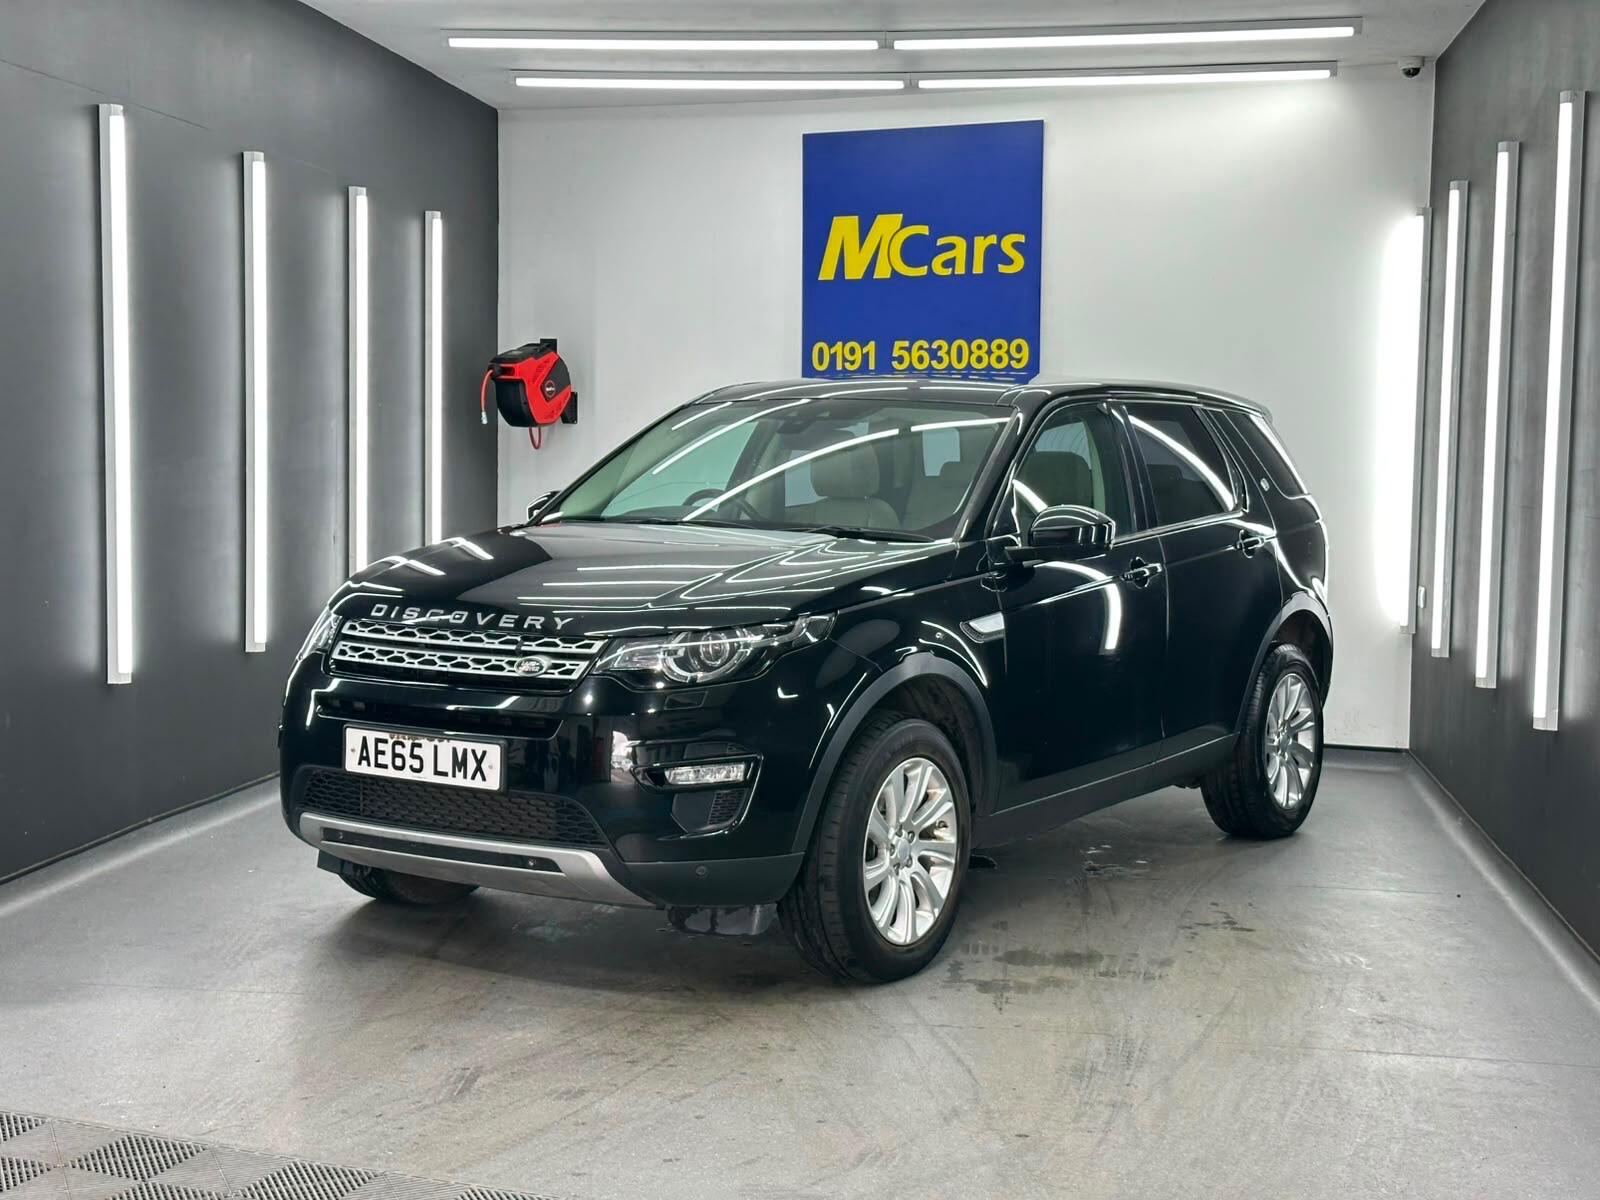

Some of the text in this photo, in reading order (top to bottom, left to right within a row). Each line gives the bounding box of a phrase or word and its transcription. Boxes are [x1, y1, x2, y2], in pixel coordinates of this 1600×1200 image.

[818, 213, 1026, 281] MCars
[811, 338, 1029, 372] 0191 5630889
[370, 603, 574, 630] DISCOVERY
[357, 735, 488, 782] AE65 LMX
